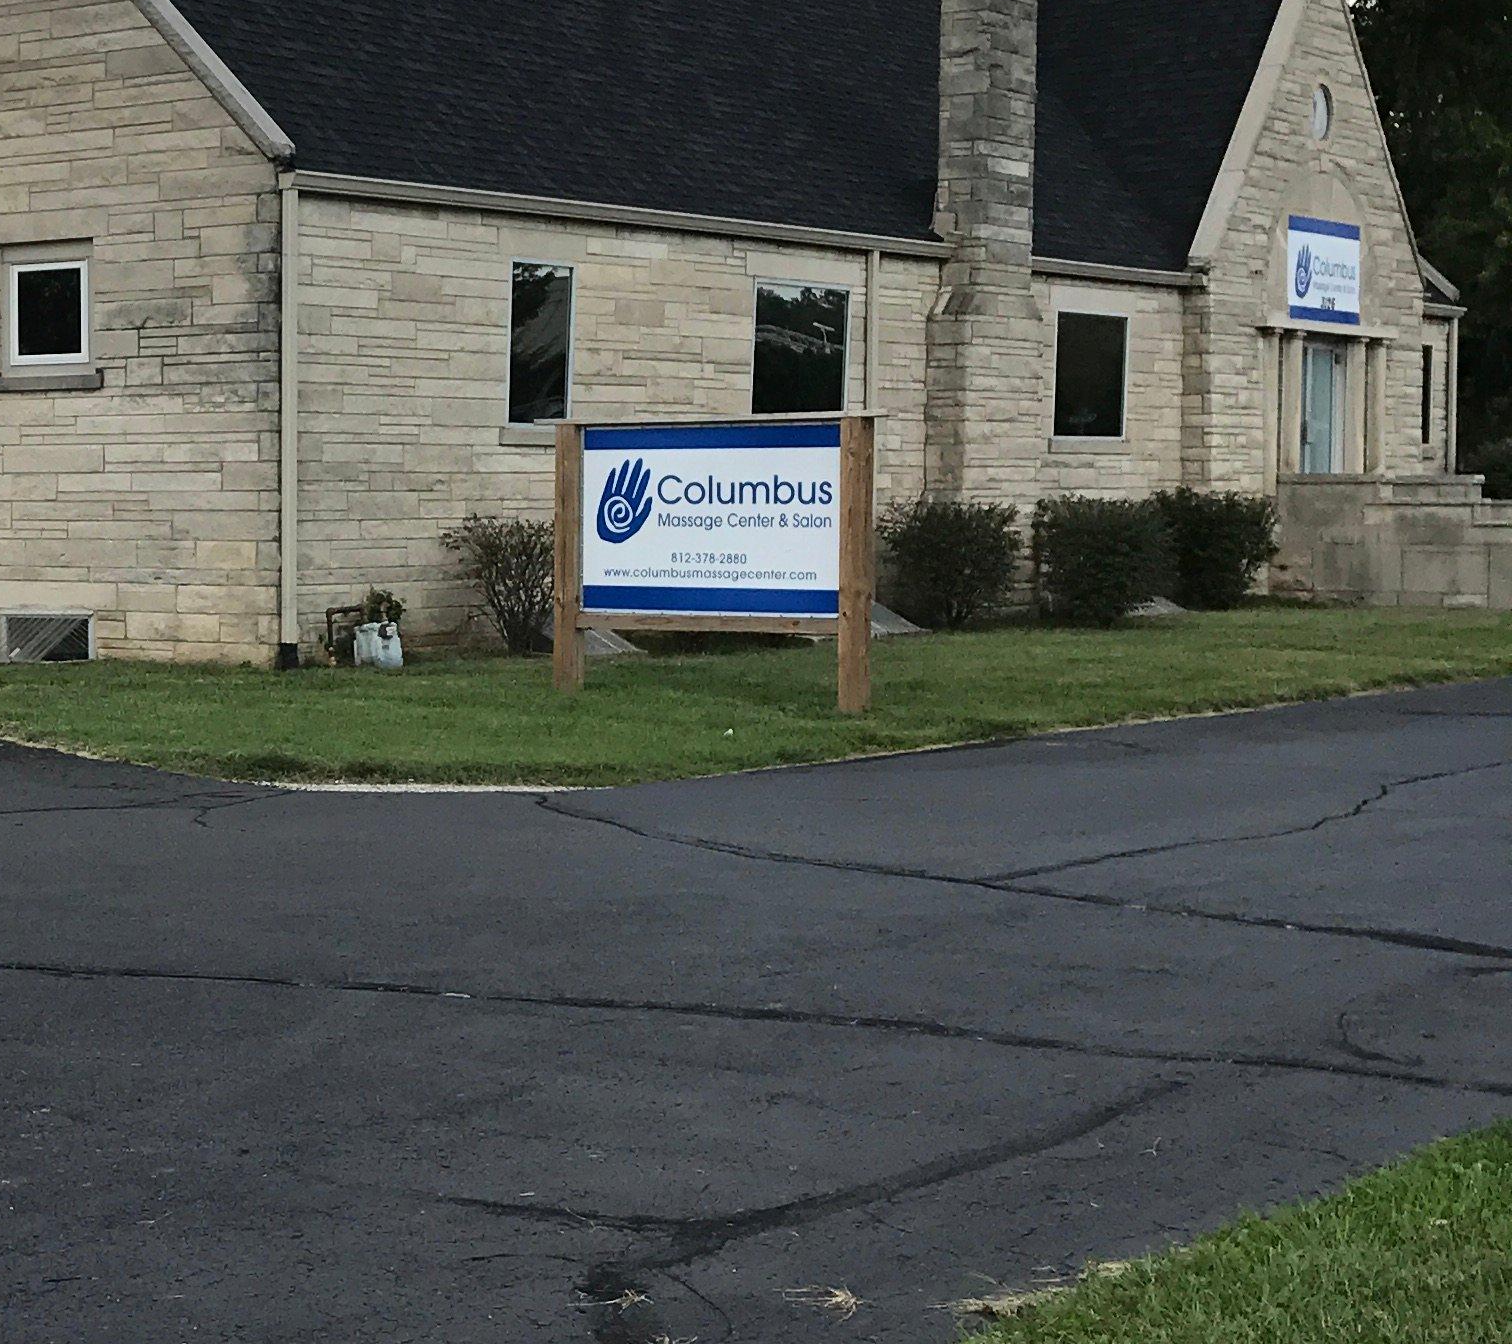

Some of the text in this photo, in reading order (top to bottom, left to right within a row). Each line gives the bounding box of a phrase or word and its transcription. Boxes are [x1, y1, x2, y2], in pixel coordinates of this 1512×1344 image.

[1313, 256, 1356, 280] Columbus
[657, 474, 833, 505] Columbus
[657, 512, 832, 531] Massage Center & Salon
[670, 552, 747, 565] 812-378-2880
[603, 566, 817, 582] www.columbusmassagecenter.com
